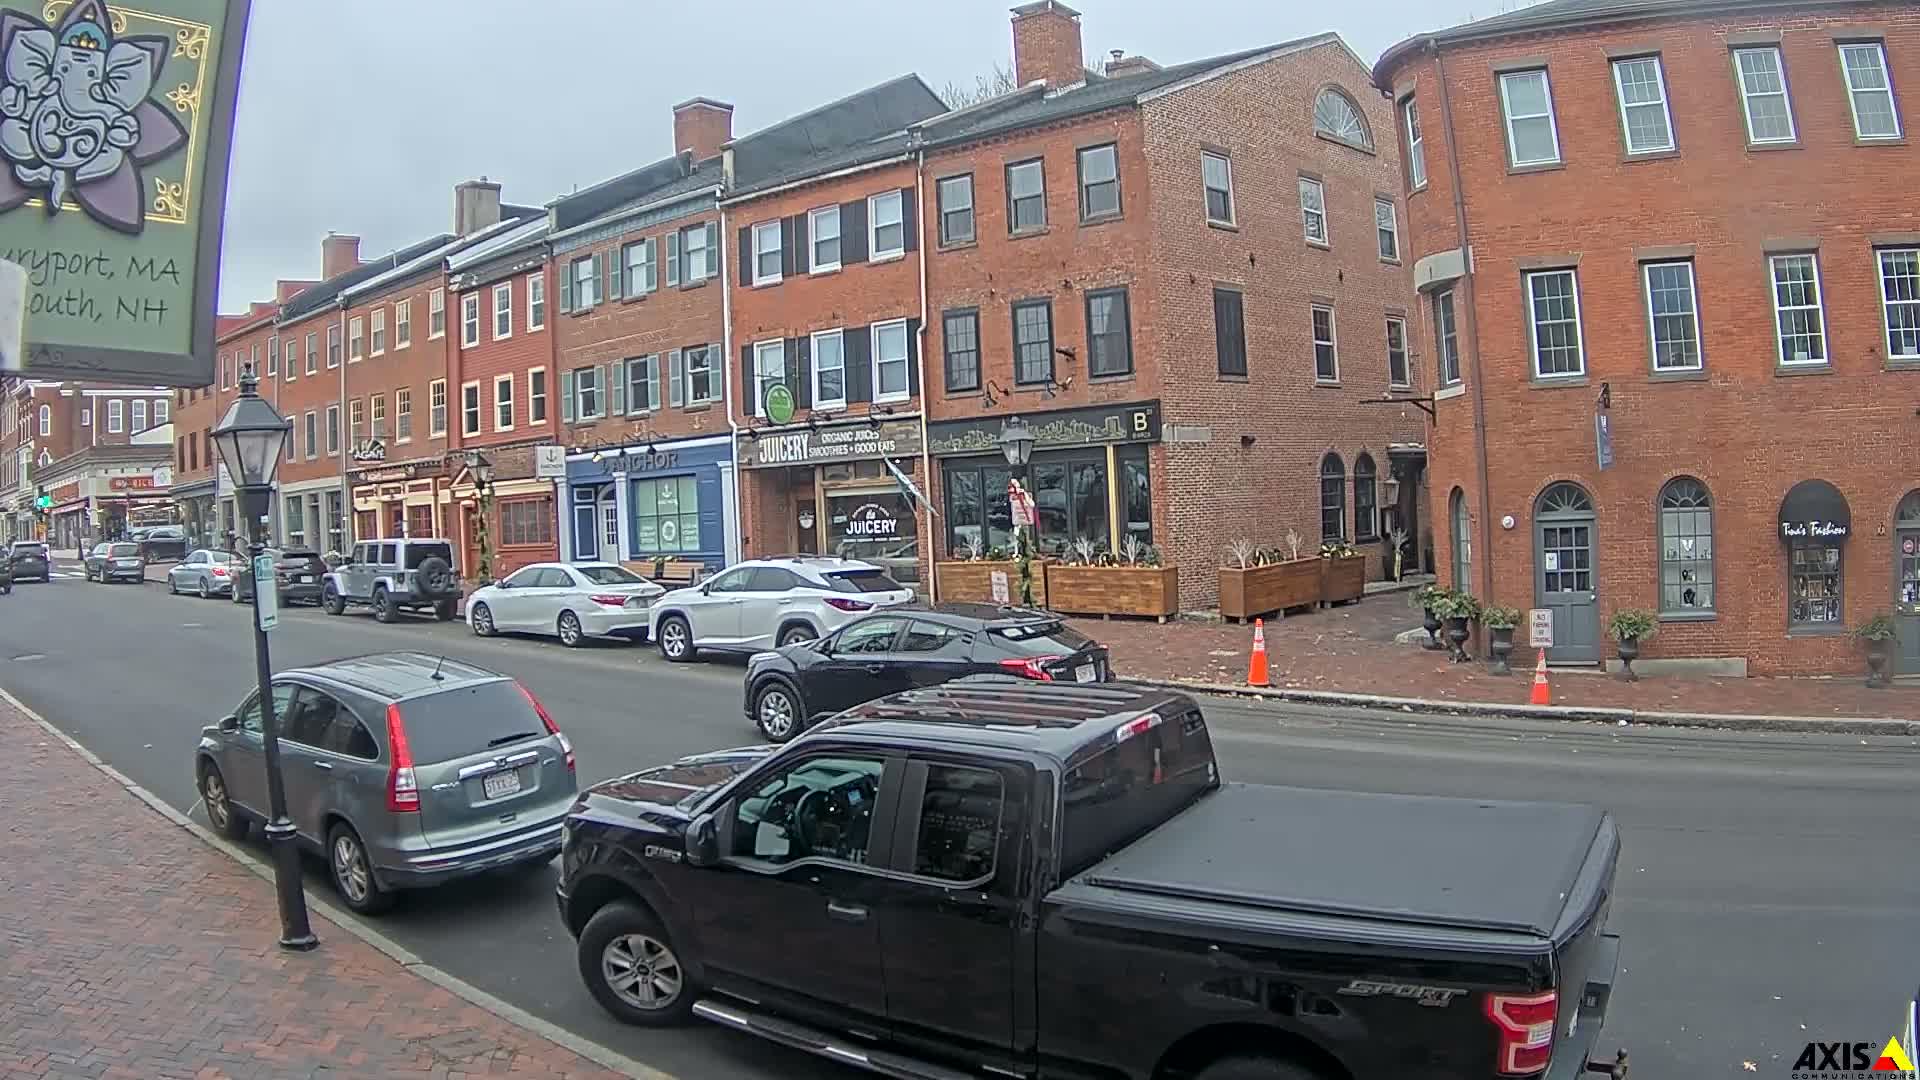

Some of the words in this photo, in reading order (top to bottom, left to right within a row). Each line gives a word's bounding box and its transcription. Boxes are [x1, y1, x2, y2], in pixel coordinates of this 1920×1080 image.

[5, 247, 115, 287] ryport,
[126, 254, 180, 284] MA
[29, 289, 103, 323] outh,
[115, 296, 169, 325] NH
[1133, 412, 1148, 432] B
[821, 431, 853, 444] ORGANIC
[854, 429, 880, 442] JUICES
[759, 433, 810, 464] JUICERY
[808, 444, 849, 458] SMOOTHIES
[854, 442, 877, 455] GOOD
[877, 440, 896, 452] EATS
[845, 517, 898, 535] JUICERY
[1808, 521, 1847, 538] Fashion
